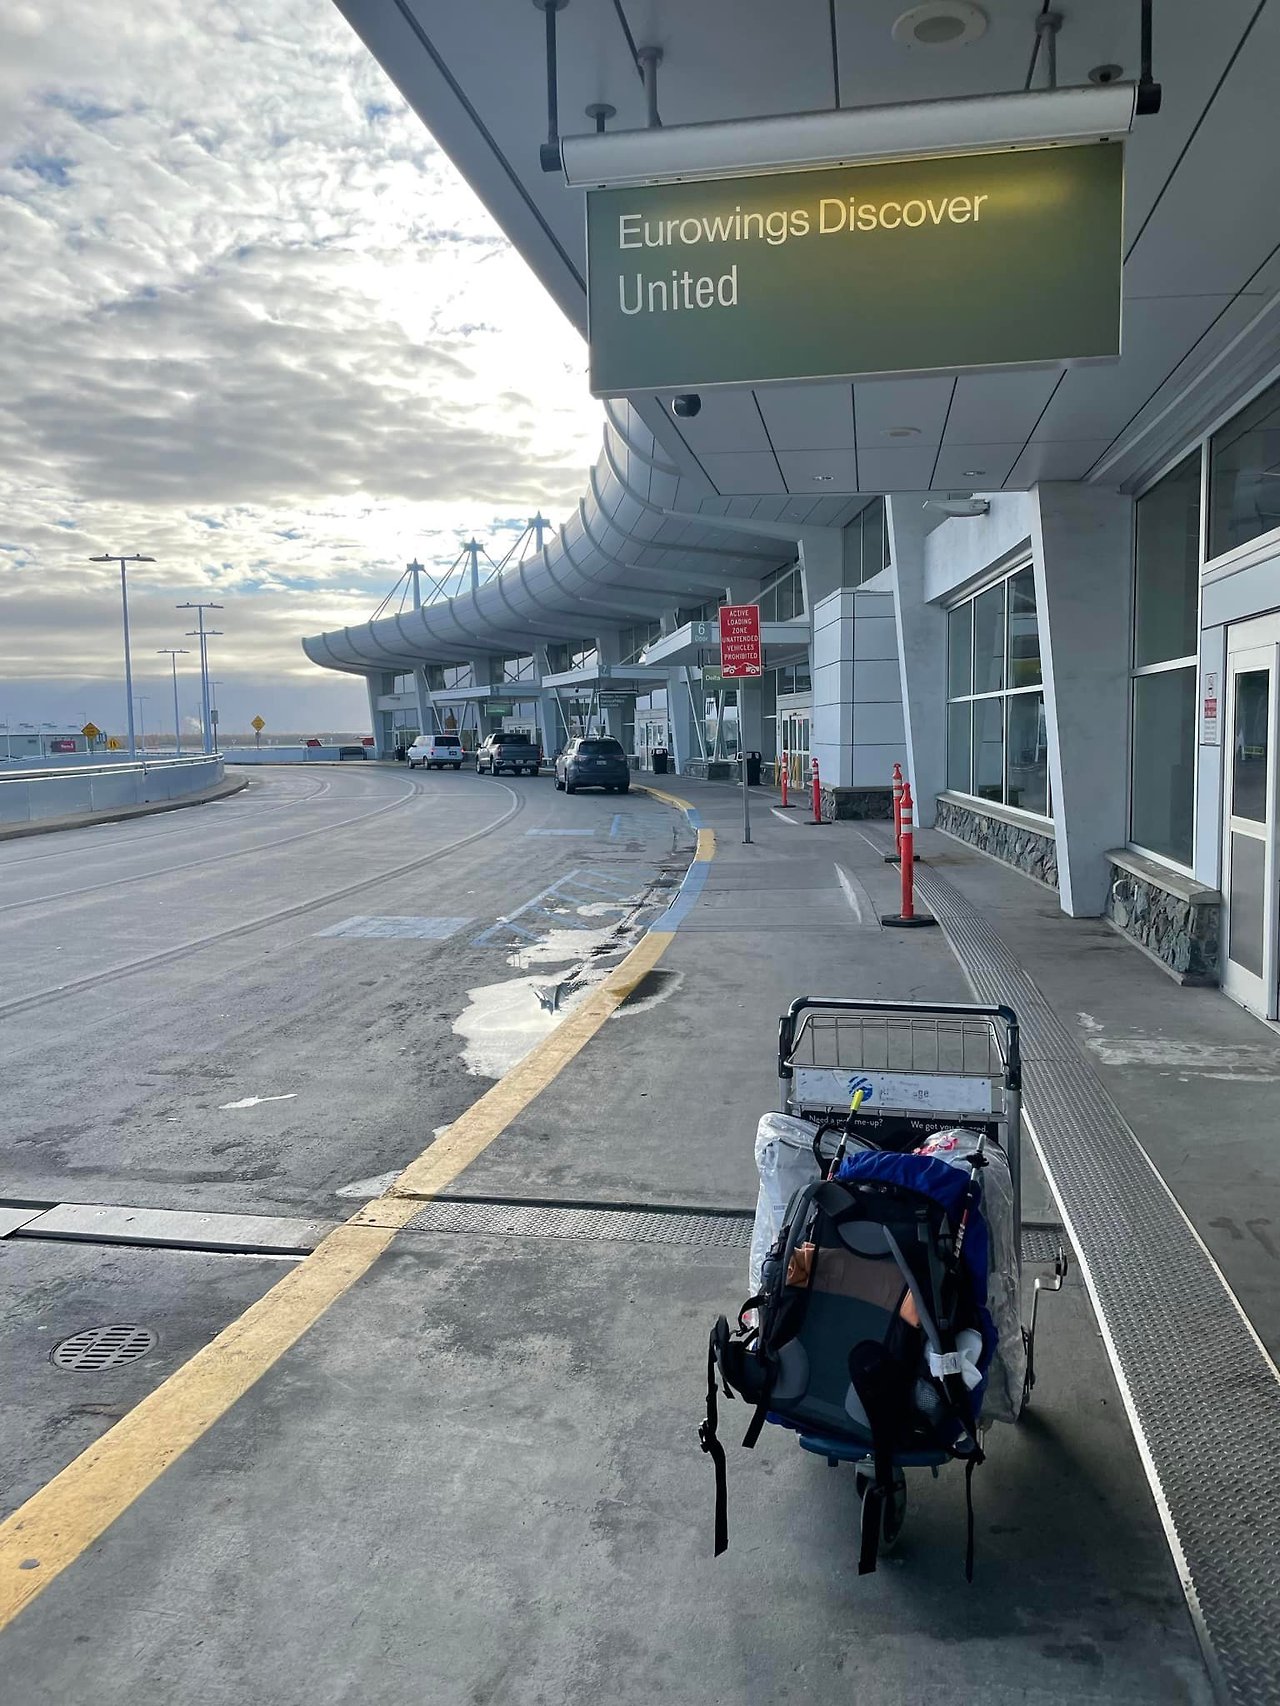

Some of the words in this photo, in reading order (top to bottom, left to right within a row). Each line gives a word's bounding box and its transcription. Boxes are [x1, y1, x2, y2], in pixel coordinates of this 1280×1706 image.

[618, 206, 811, 250] Eurowings
[818, 194, 989, 235] Discover
[618, 265, 739, 315] United
[729, 609, 750, 617] ACTIVE
[727, 618, 752, 626] LOADING
[698, 623, 706, 635] 6
[722, 635, 759, 643] UNATTENDED
[726, 643, 755, 651] VEHICLES
[724, 652, 758, 660] PROHIBITED
[809, 1115, 829, 1124] Need
[910, 1120, 924, 1129] We
[925, 1123, 938, 1132] got
